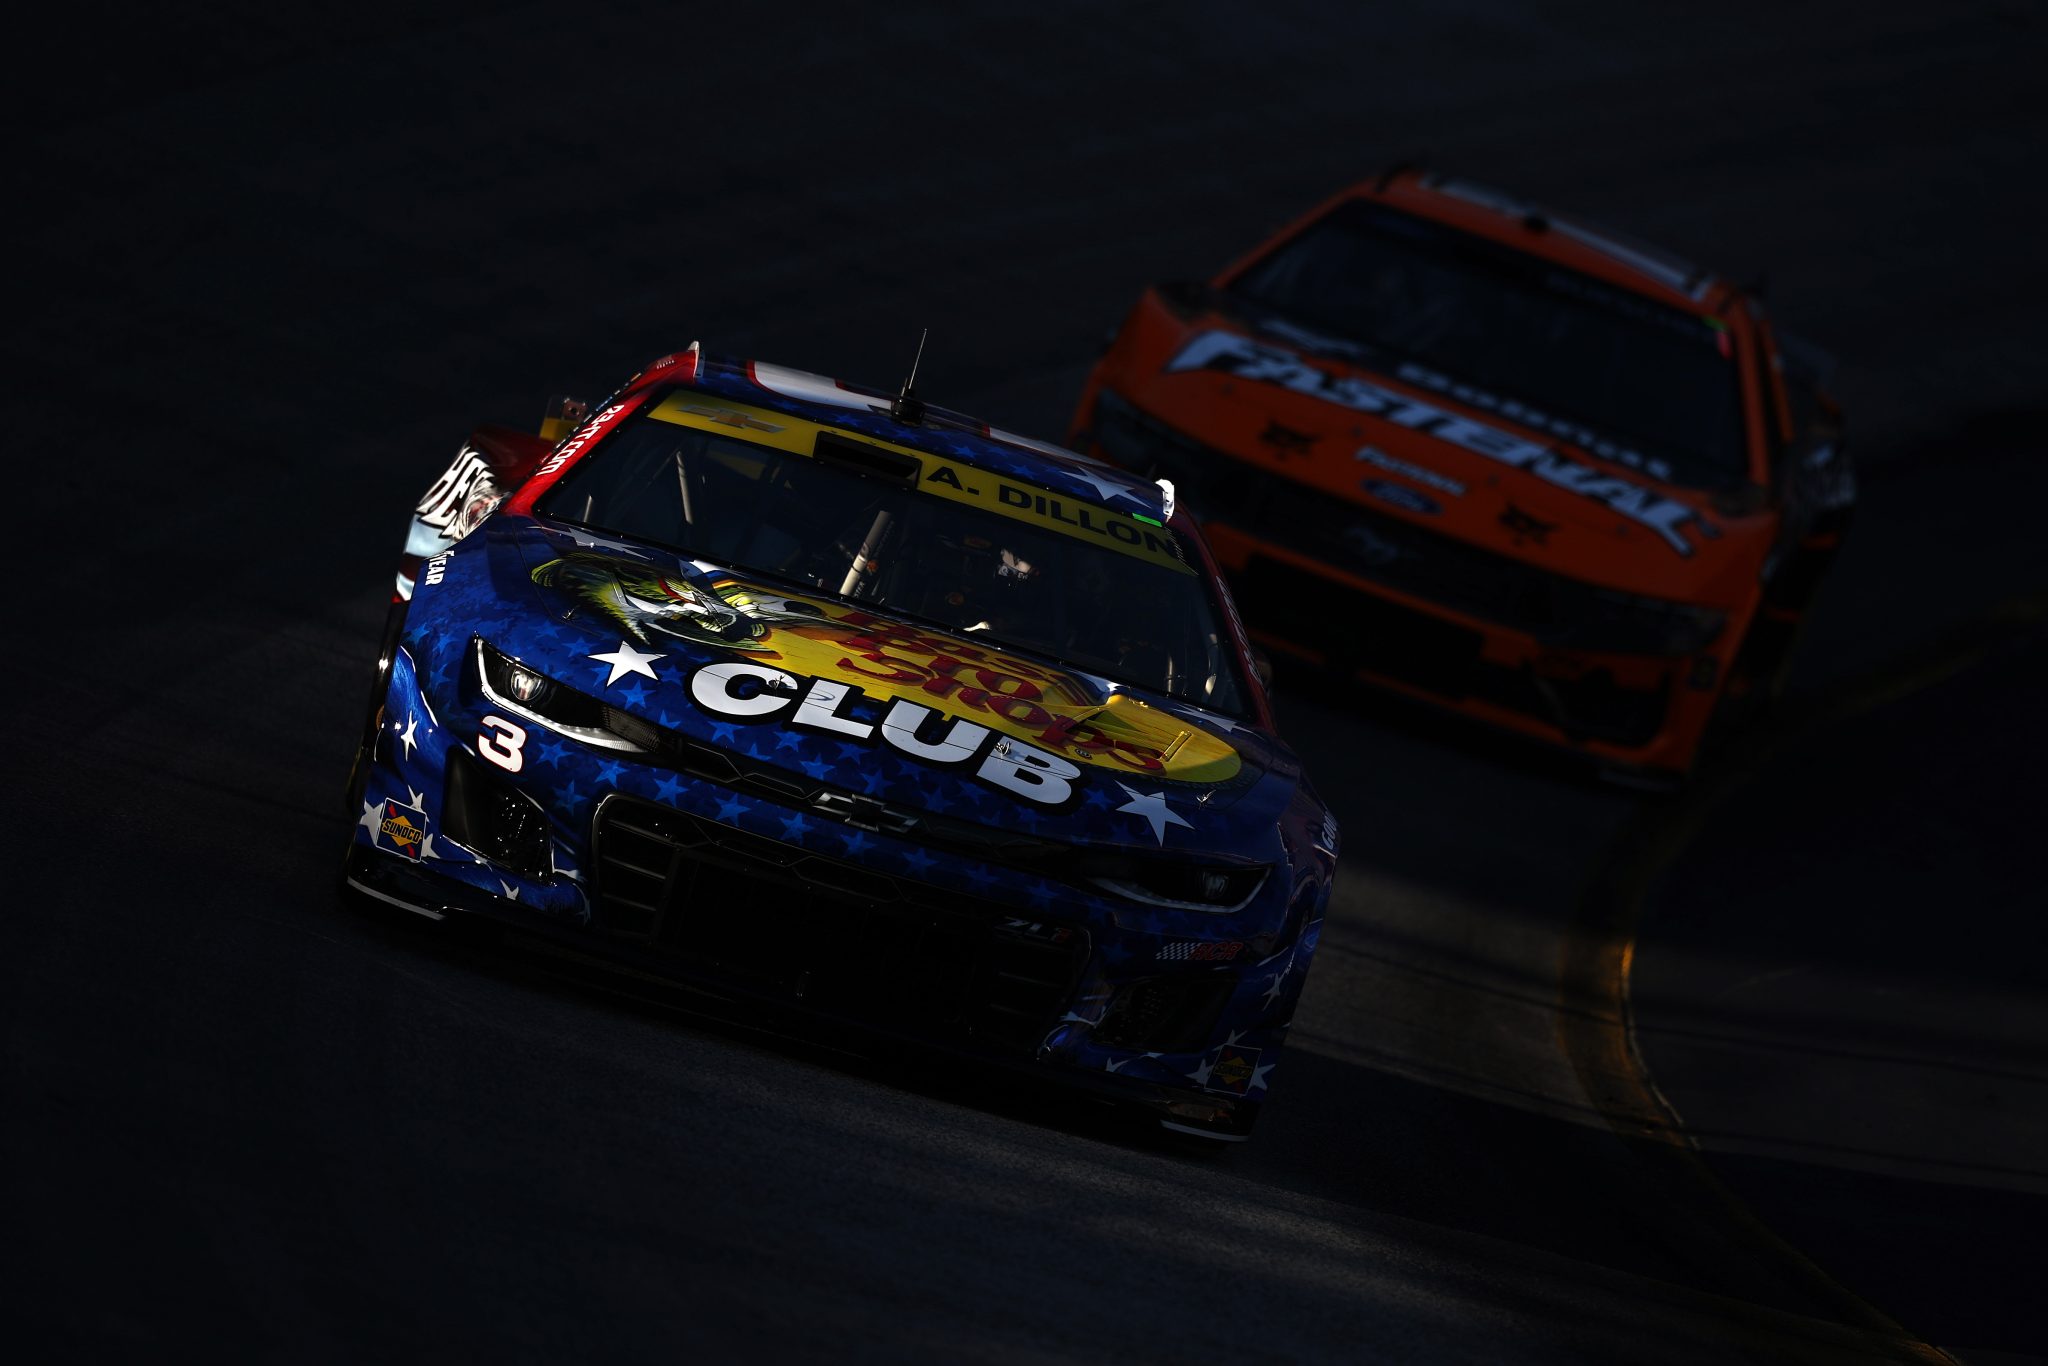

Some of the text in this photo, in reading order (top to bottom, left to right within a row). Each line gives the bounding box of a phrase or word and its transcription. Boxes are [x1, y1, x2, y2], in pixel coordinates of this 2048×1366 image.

[1164, 329, 1694, 555] FASTENAL
[927, 465, 1181, 559] A. DILLON
[478, 715, 527, 774] 3
[691, 662, 1082, 805] CLUB
[836, 654, 1167, 776] Shops
[382, 818, 422, 844] SUNOCO
